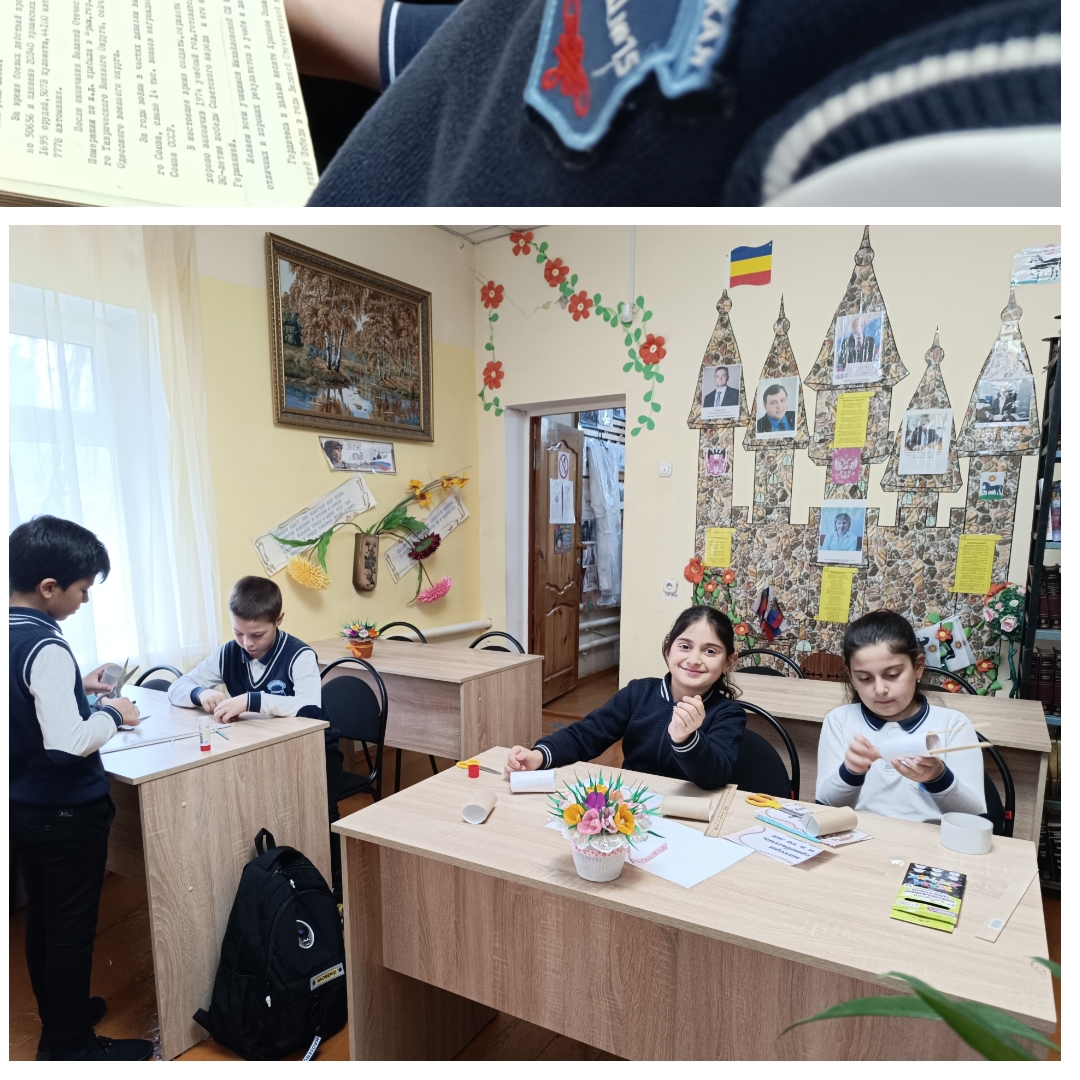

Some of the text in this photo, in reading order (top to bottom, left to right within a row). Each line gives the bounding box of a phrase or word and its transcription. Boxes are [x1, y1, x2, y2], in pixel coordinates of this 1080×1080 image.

[12, 13, 22, 107] время боевых действий
[72, 27, 81, 60] Великой
[133, 43, 148, 129] годы войны частях
[204, 63, 217, 109] Советского
[244, 51, 260, 100] результатов
[53, 86, 62, 159] 7778 автомашин.
[73, 106, 83, 132] После
[112, 48, 126, 169] Одесского военного округа.
[165, 122, 179, 178] Союза СССР.
[227, 137, 242, 188] Германией.
